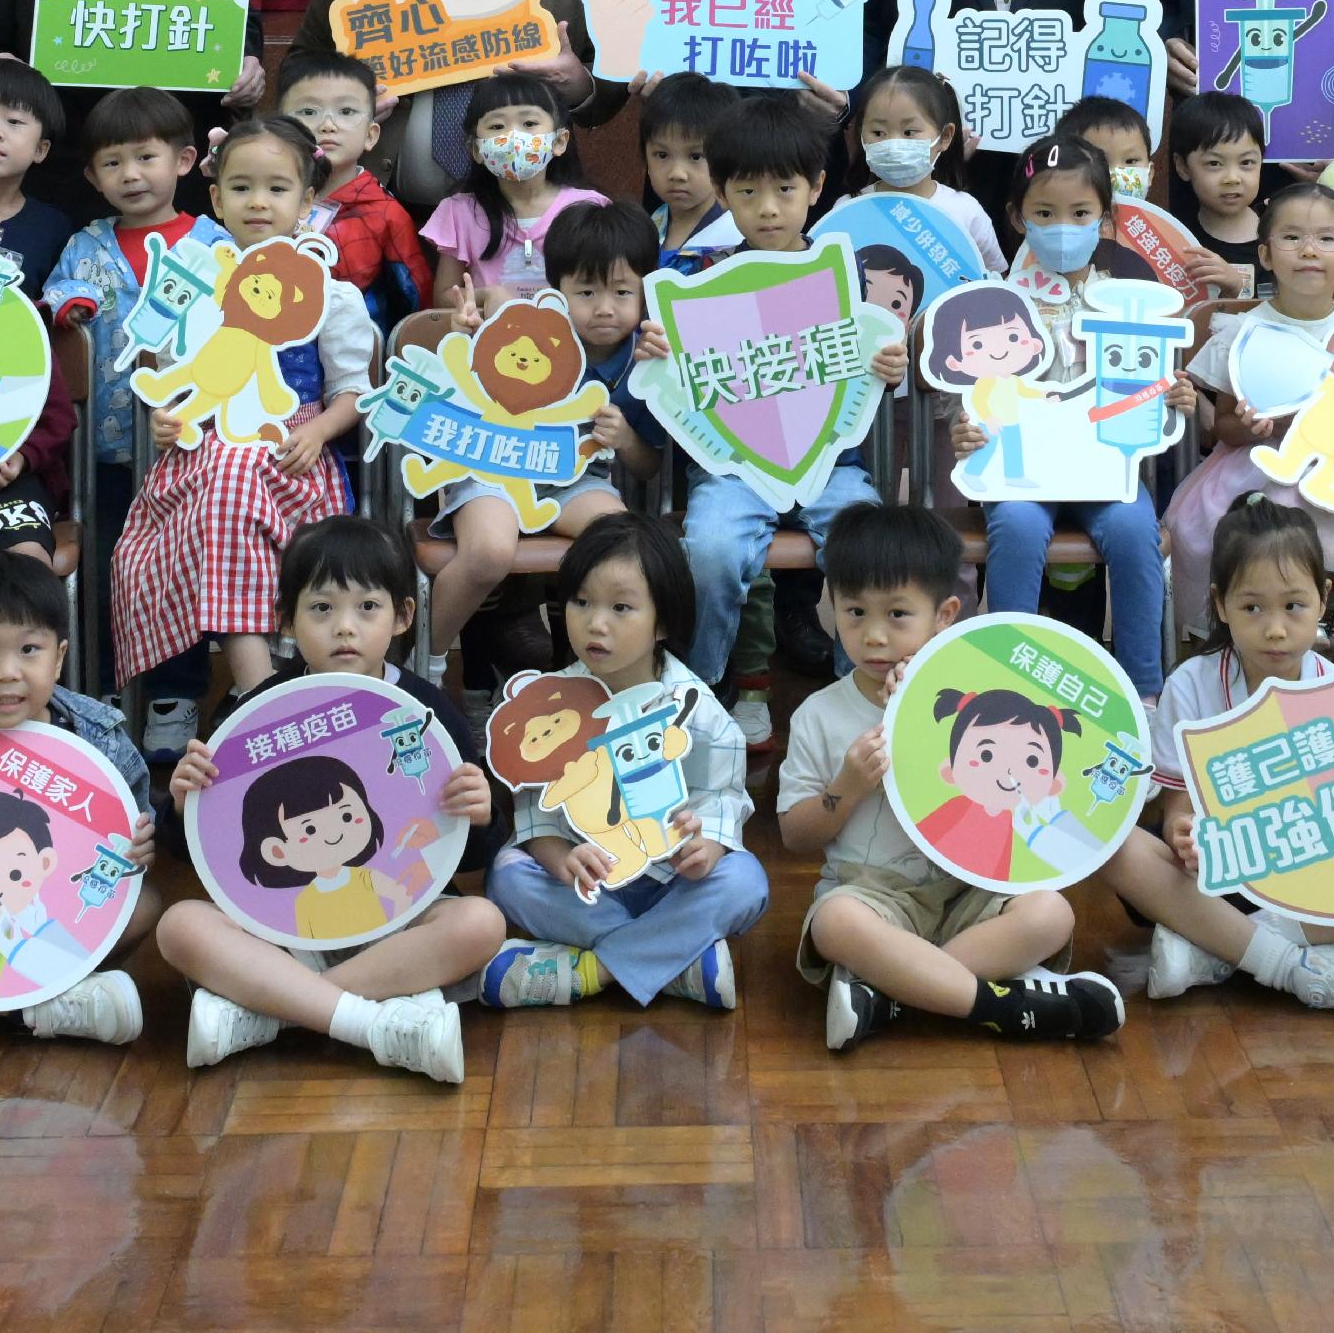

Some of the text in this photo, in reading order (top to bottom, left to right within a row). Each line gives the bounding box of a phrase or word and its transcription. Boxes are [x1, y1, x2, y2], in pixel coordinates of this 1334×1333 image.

[70, 0, 215, 54] 快打針
[683, 35, 818, 80] 打咗啦
[956, 17, 1067, 73] 記得
[889, 200, 962, 279] 減少併發症
[1123, 214, 1201, 300] 增強免疫力
[678, 316, 874, 414] 快接種
[422, 413, 561, 475] 我打咗啦
[1008, 640, 1111, 720] 保護自己
[243, 701, 358, 765] 接種疫苗
